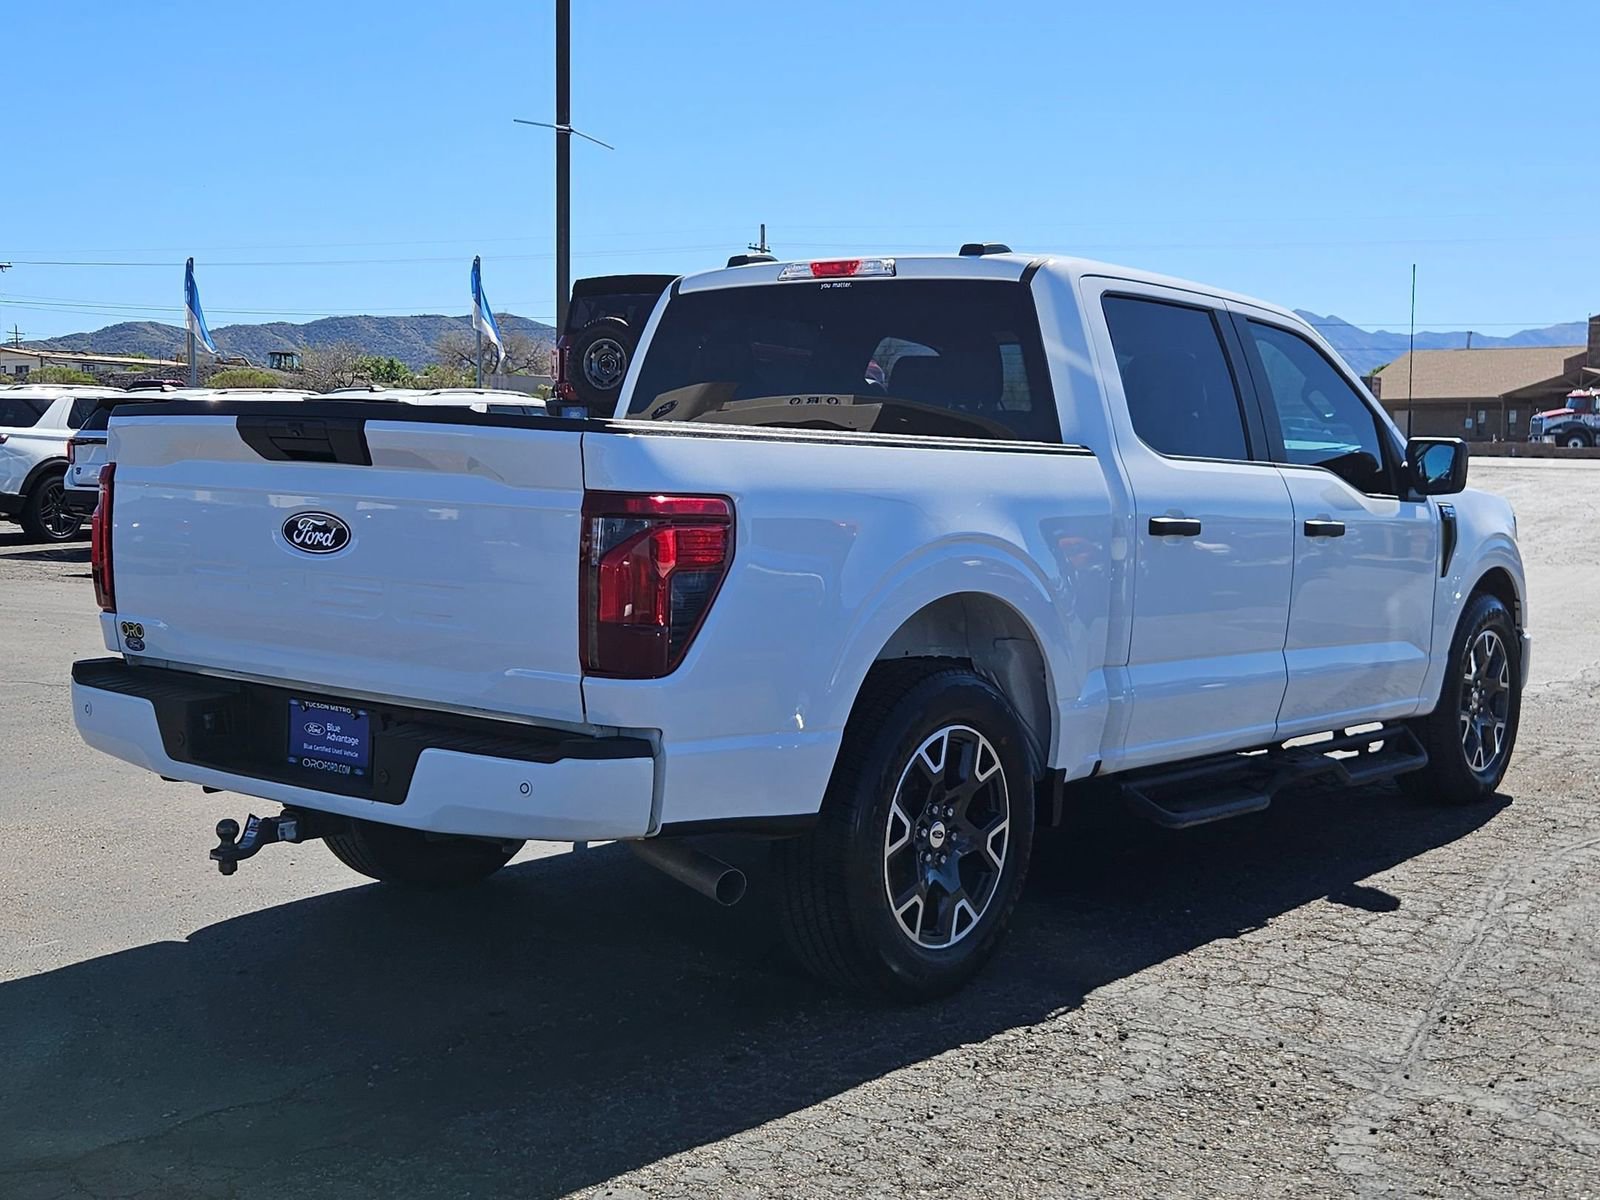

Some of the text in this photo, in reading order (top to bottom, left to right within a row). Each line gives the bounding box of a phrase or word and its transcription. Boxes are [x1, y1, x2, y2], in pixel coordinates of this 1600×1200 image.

[293, 517, 337, 547] Ford
[121, 622, 143, 638] ORO
[304, 701, 352, 714] TUCSON METRO
[326, 723, 341, 733] Blue
[326, 733, 359, 746] Advantage
[313, 744, 331, 753] Certified
